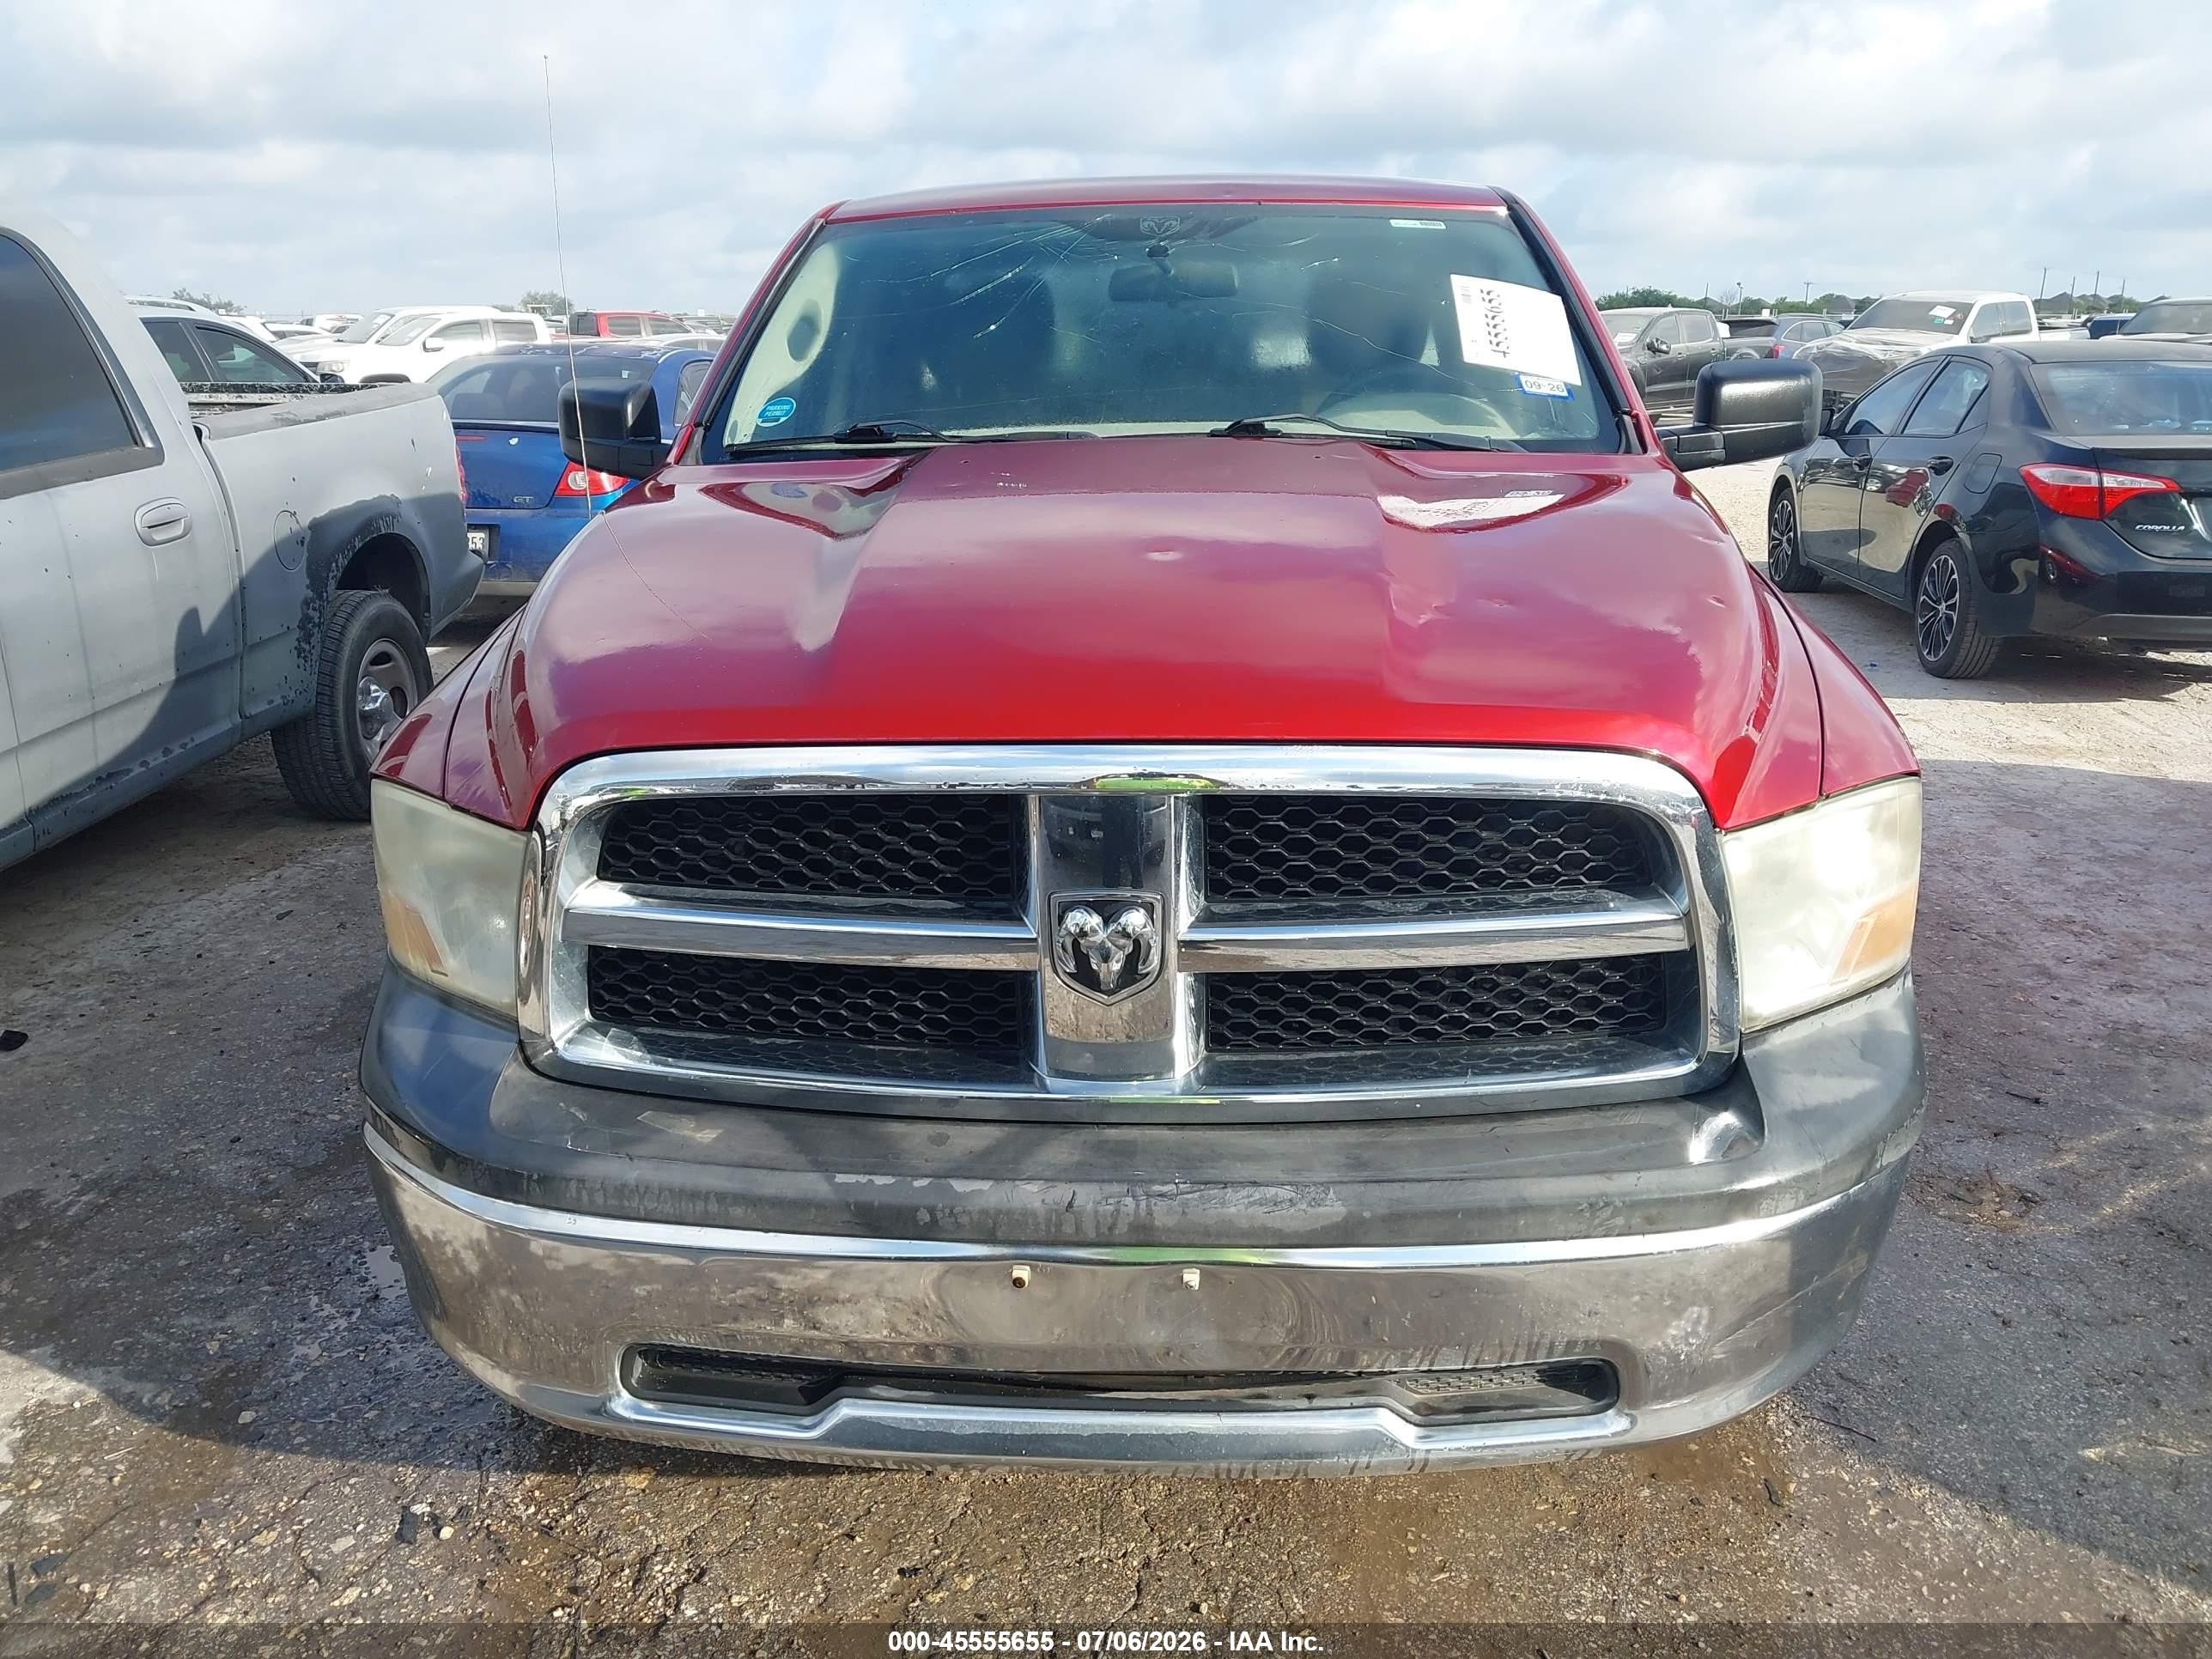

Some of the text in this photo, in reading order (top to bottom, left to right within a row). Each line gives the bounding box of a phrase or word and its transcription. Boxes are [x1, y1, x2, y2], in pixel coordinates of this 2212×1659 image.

[1480, 289, 1510, 358] 45555655
[1524, 380, 1565, 392] 09 26
